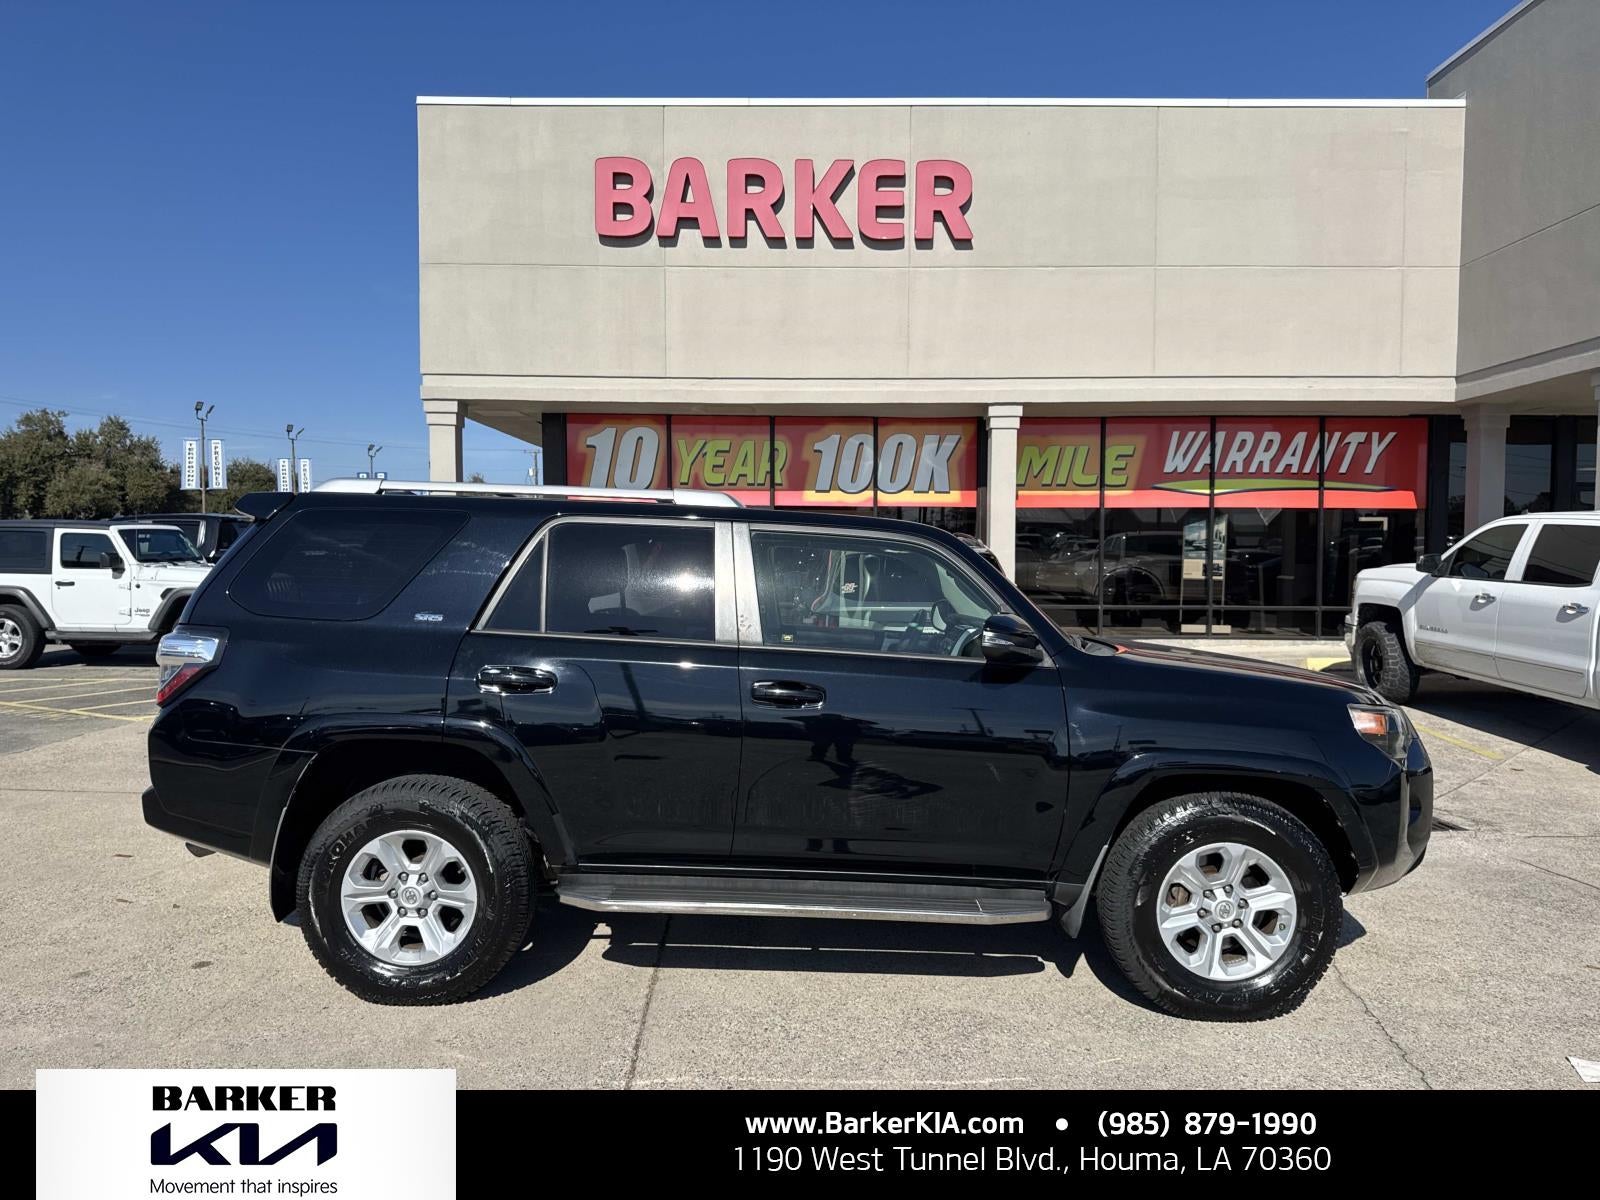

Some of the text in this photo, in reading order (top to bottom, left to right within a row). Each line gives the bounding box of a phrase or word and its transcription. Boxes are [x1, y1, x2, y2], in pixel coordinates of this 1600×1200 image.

[594, 156, 974, 242] BARKER
[585, 425, 1398, 495] 10 YEAR 100K MILE WARRANTY
